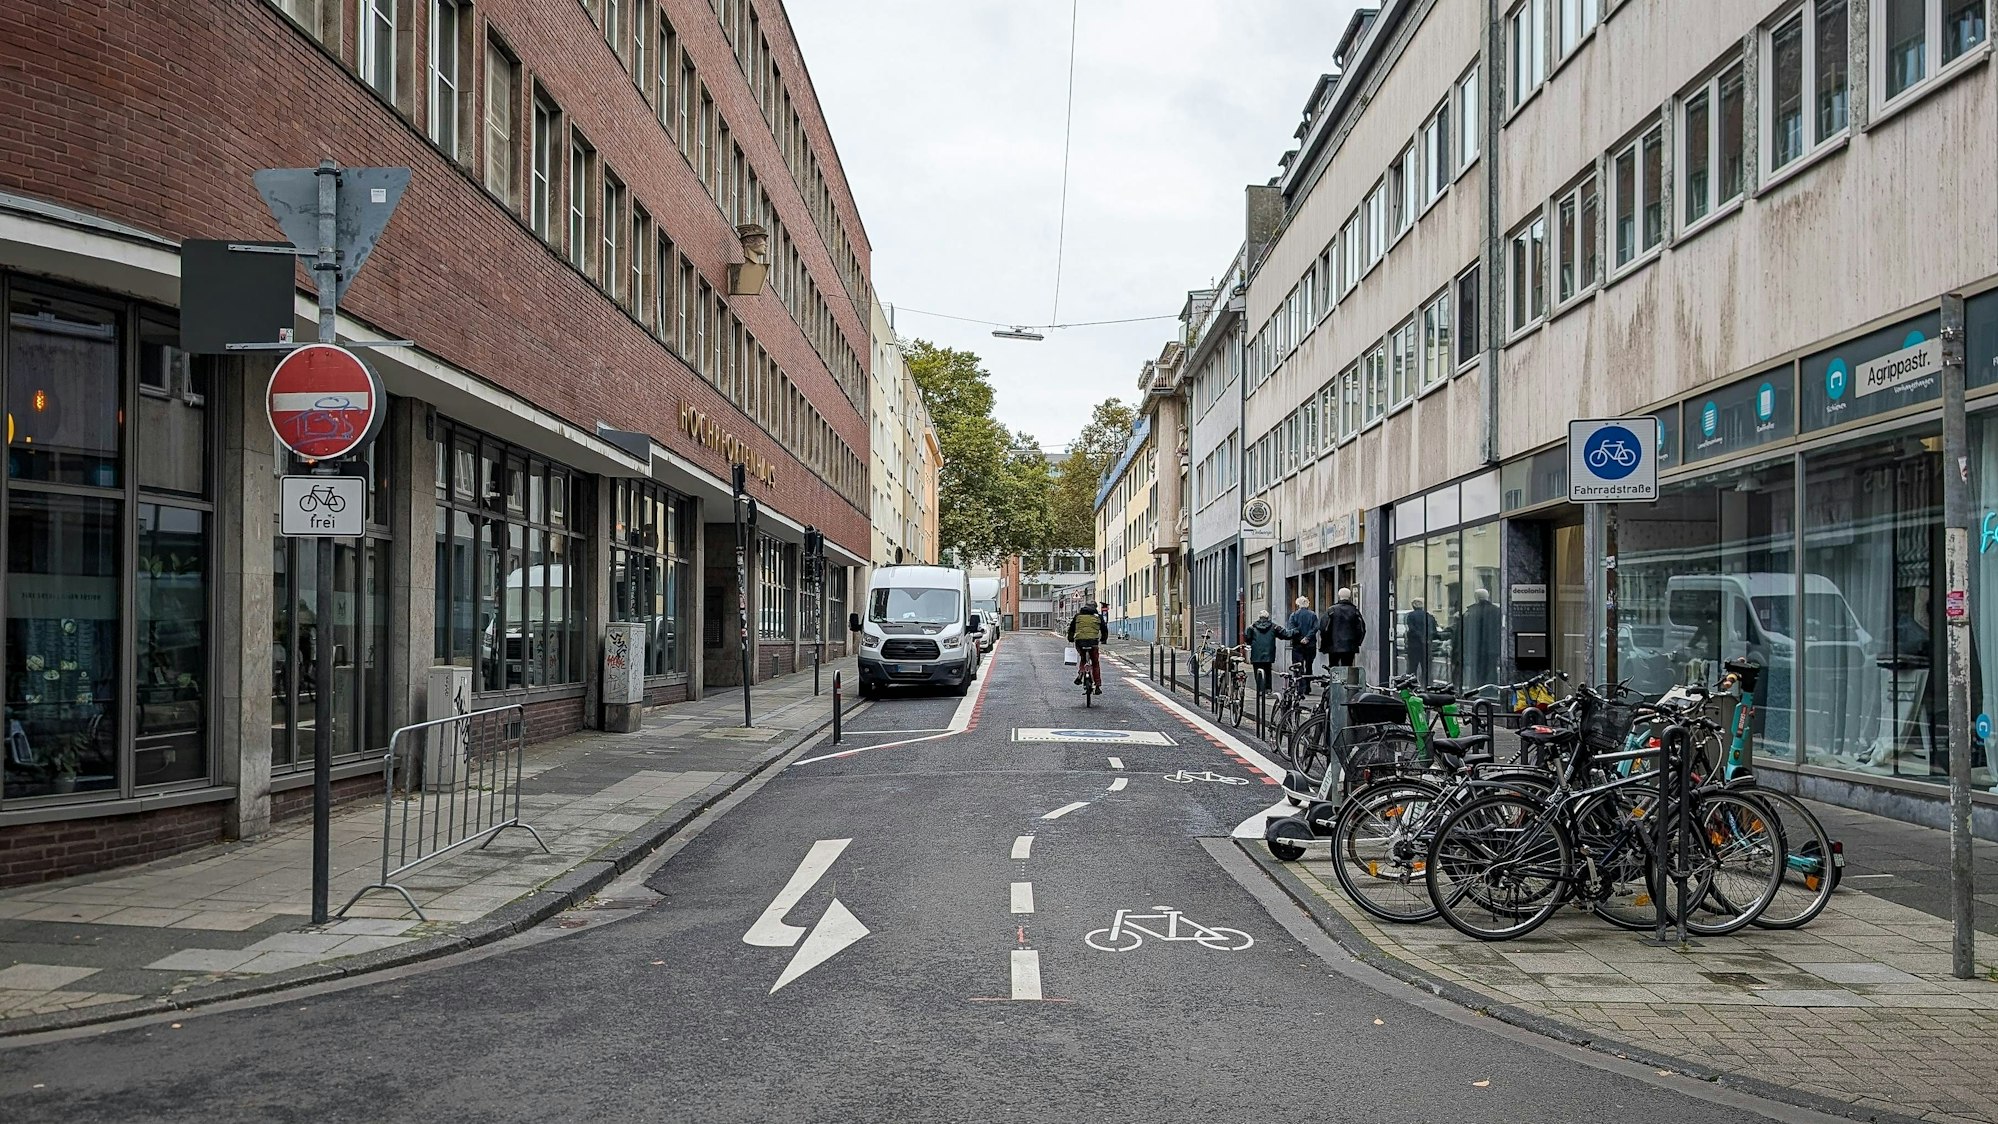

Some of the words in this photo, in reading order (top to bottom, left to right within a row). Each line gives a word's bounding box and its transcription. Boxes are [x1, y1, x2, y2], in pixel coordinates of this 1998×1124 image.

[1867, 349, 1931, 386] Agrippastr.
[1574, 484, 1652, 495] Fahrradstraße
[310, 515, 335, 529] frei
